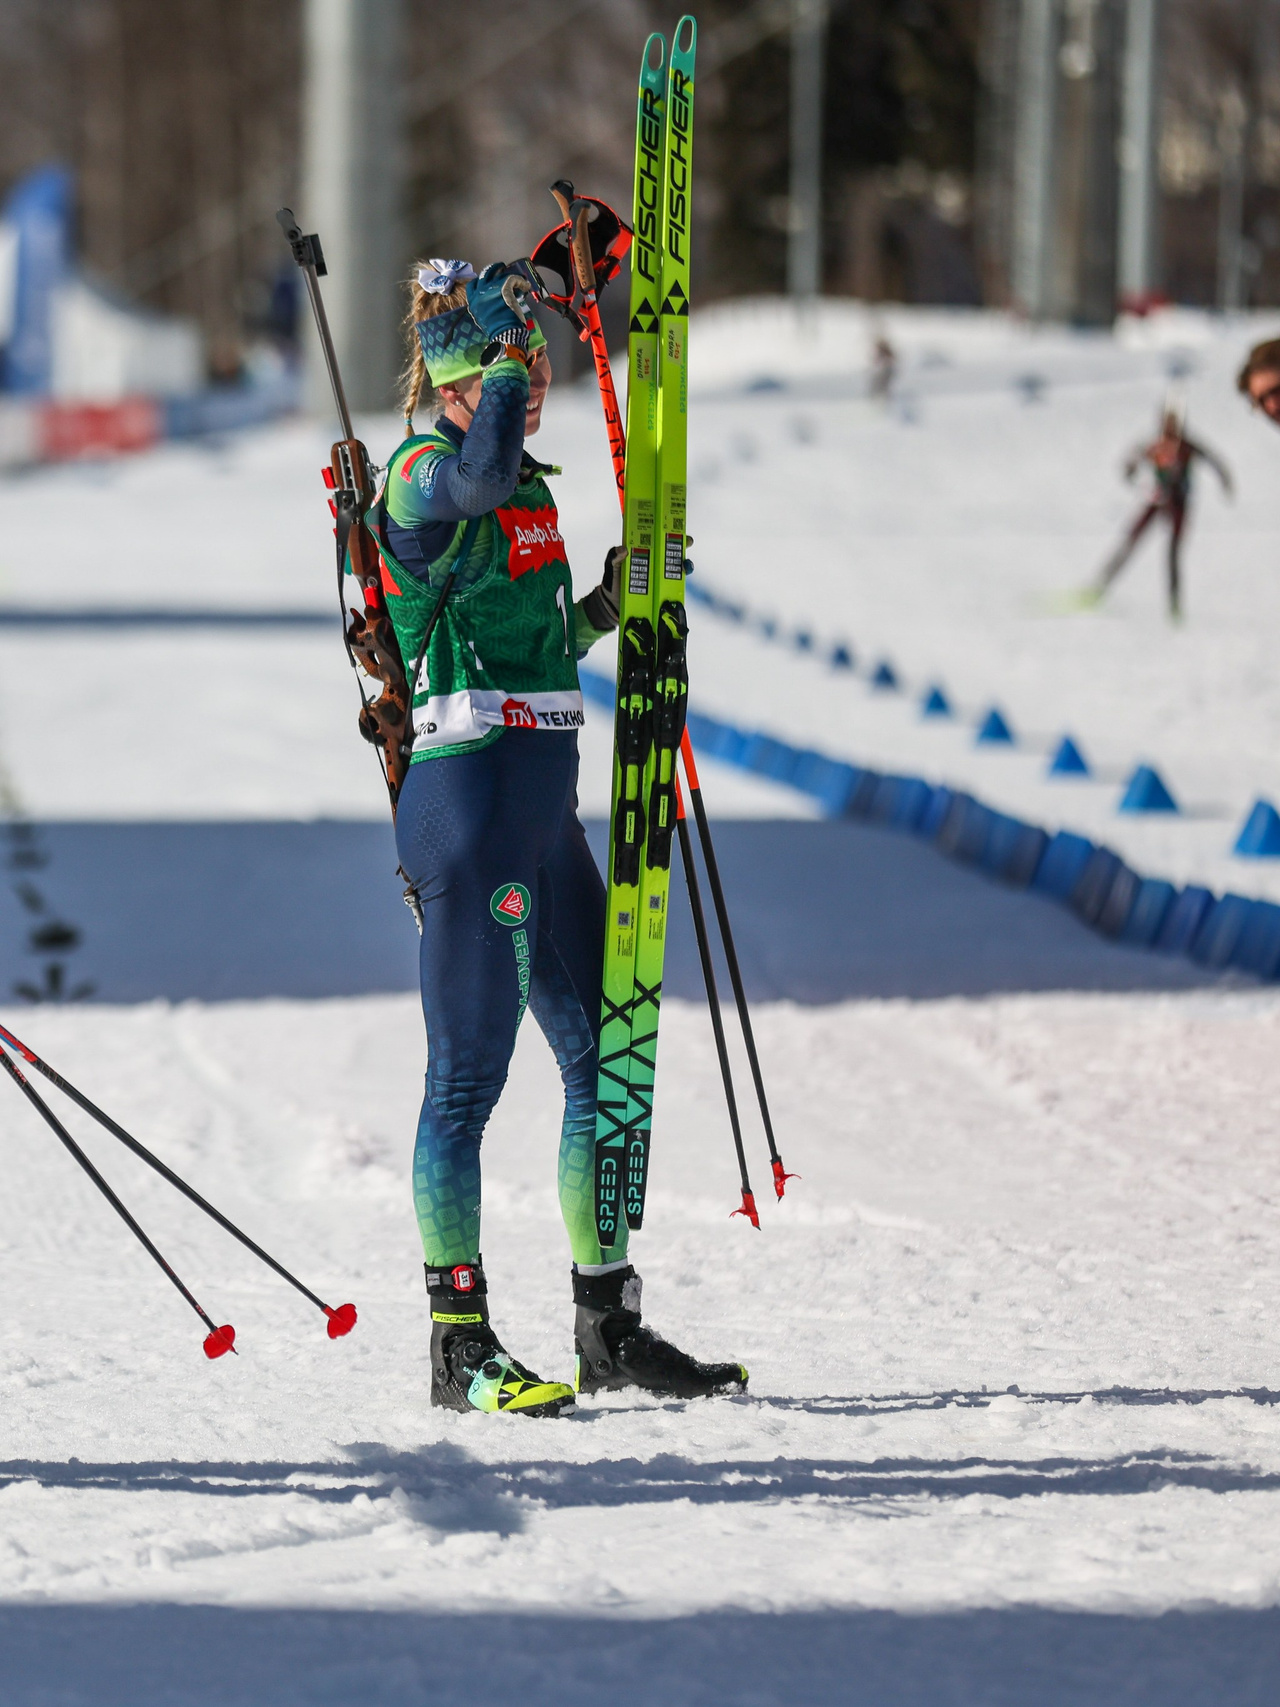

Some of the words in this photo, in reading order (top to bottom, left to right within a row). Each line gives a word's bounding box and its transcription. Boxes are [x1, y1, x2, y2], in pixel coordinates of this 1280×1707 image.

[637, 87, 661, 285] FISCHER
[668, 68, 691, 266] FISCHER
[599, 1157, 617, 1232] SPEED
[627, 1140, 645, 1215] SPEED
[435, 1314, 478, 1323] FISCHER
